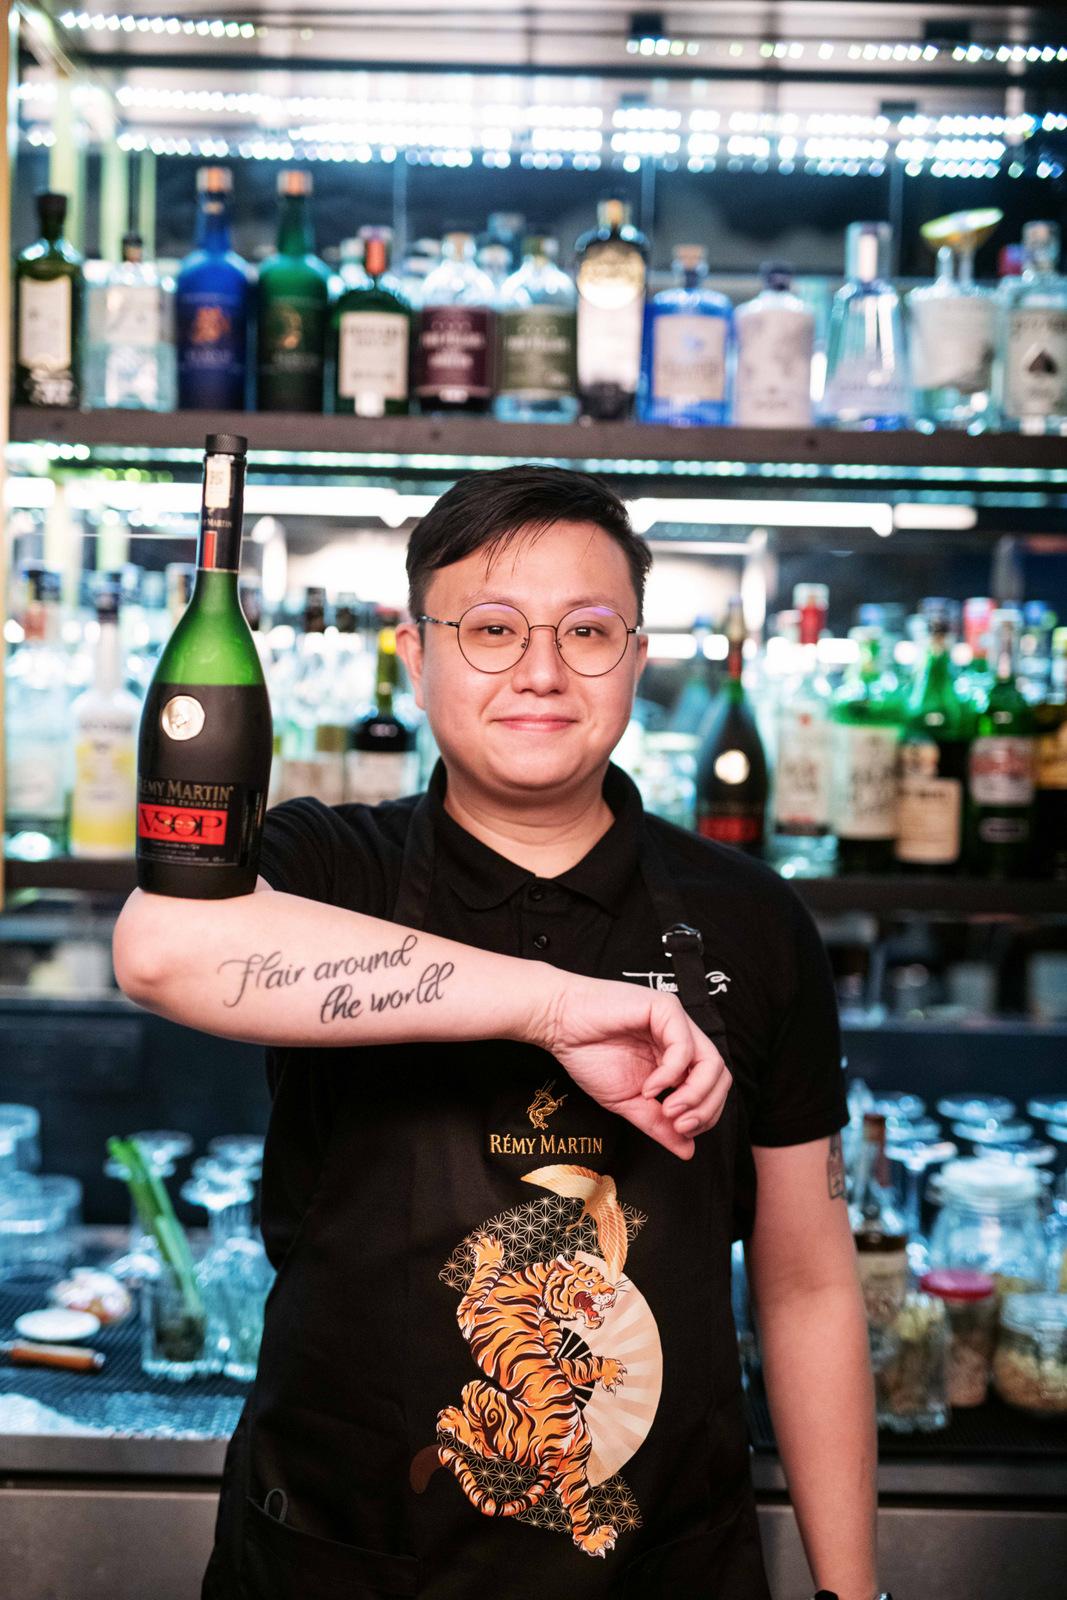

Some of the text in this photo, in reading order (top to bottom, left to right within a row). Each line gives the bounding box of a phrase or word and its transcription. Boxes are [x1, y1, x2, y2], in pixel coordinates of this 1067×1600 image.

[167, 779, 231, 802] MARTIN
[140, 807, 223, 838] VSOP
[217, 934, 418, 1009] Flair around
[320, 961, 455, 1024] the world
[488, 1133, 603, 1155] RÉMY MARTIN
